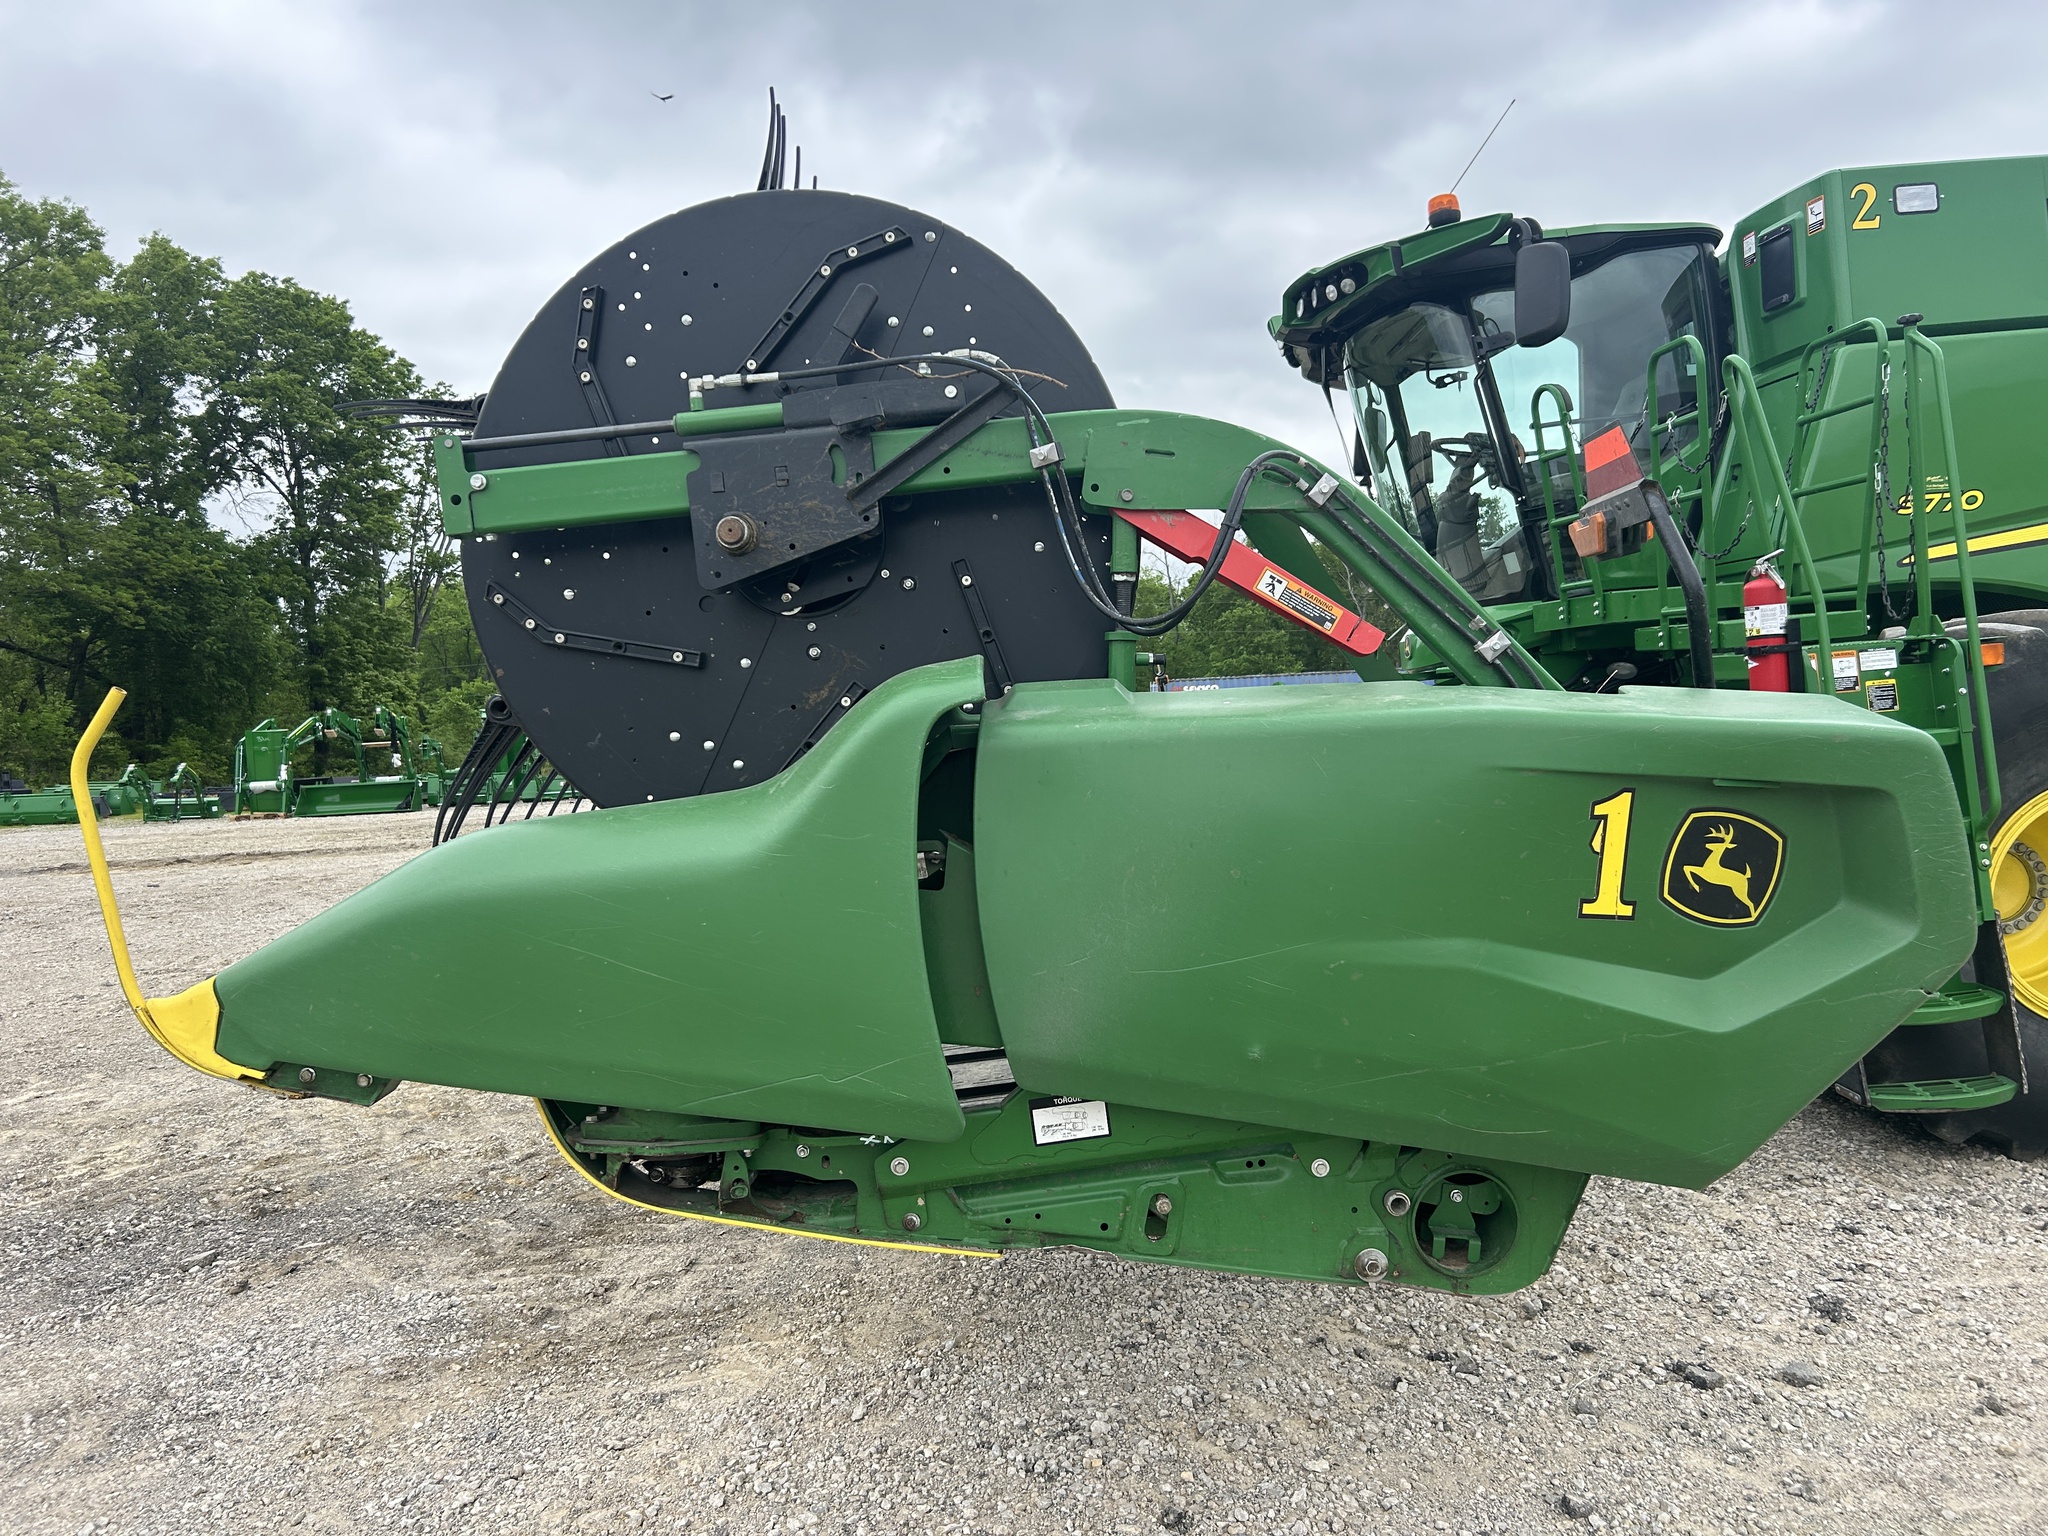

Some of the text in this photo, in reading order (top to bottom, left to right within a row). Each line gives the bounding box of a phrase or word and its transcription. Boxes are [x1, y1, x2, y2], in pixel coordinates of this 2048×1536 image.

[1849, 181, 1882, 231] 2
[1303, 590, 1334, 612] WARNING
[1577, 787, 1637, 922] 1
